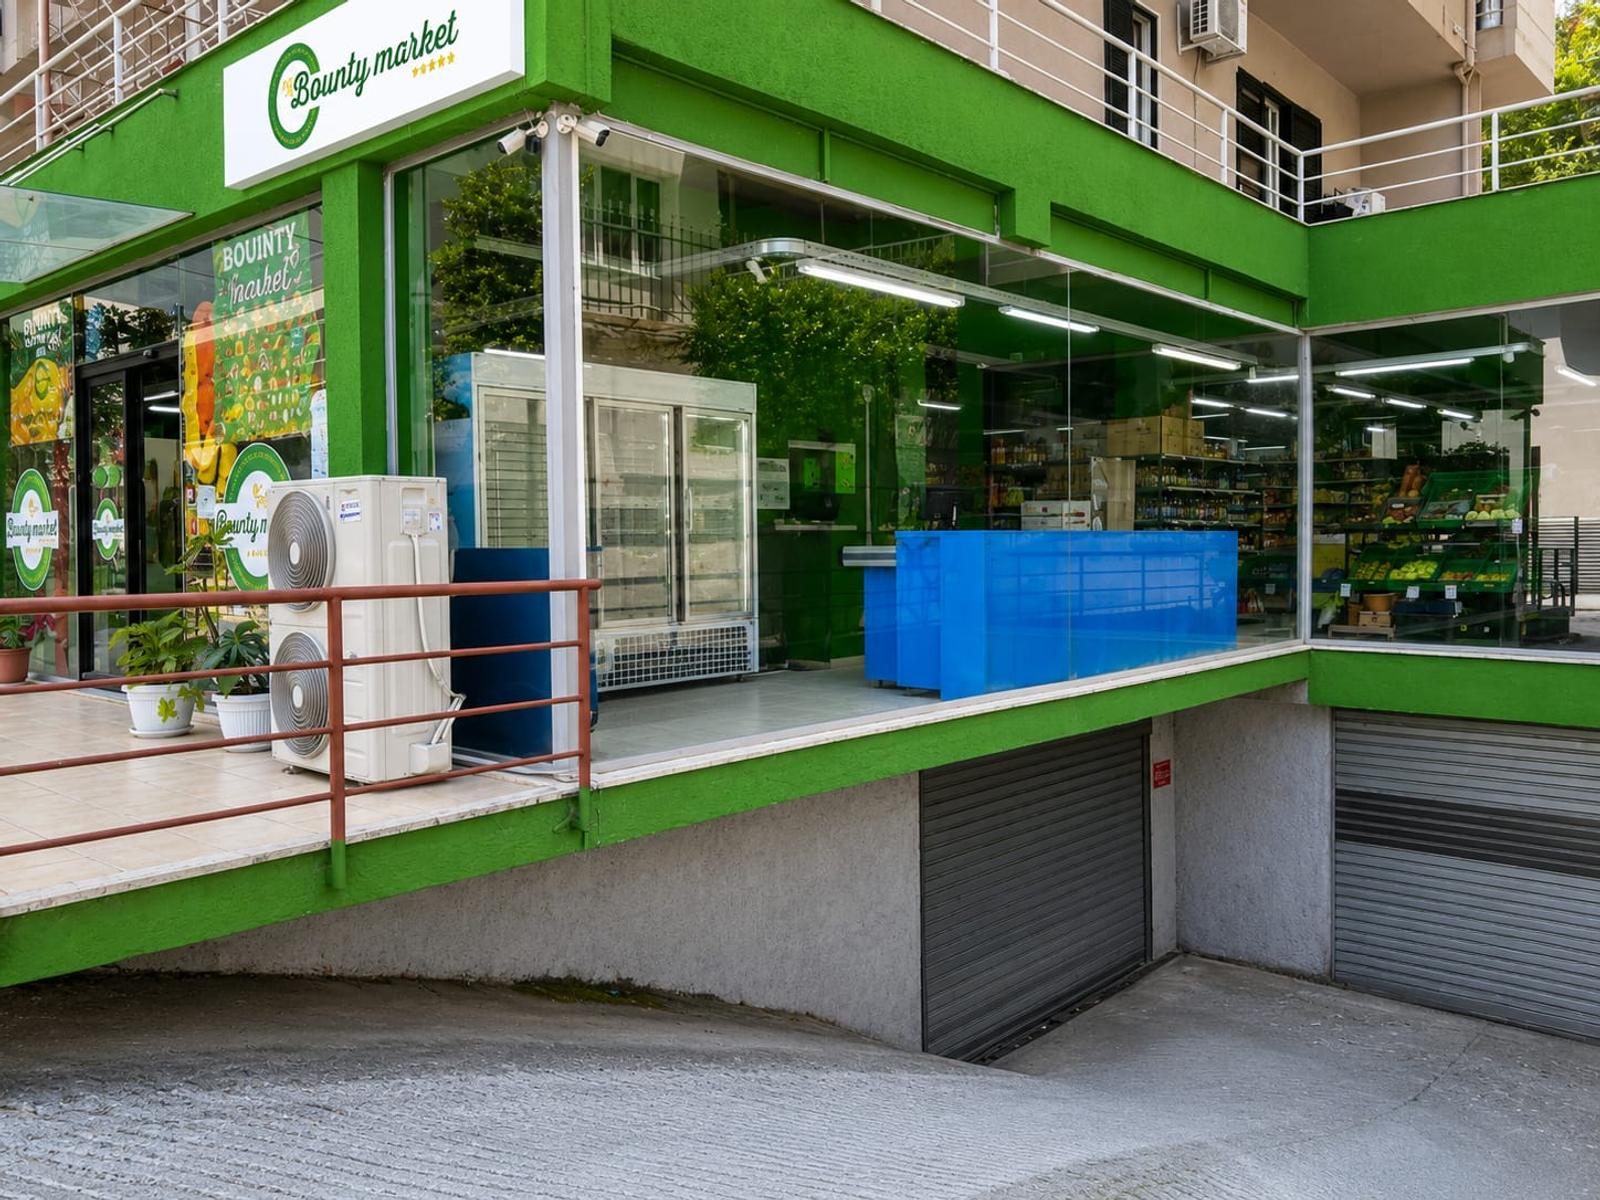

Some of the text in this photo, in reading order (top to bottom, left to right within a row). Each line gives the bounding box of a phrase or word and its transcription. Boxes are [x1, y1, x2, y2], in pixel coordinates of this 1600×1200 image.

[291, 52, 371, 109] Bounty
[373, 10, 459, 76] market
[216, 509, 259, 543] Bunty
